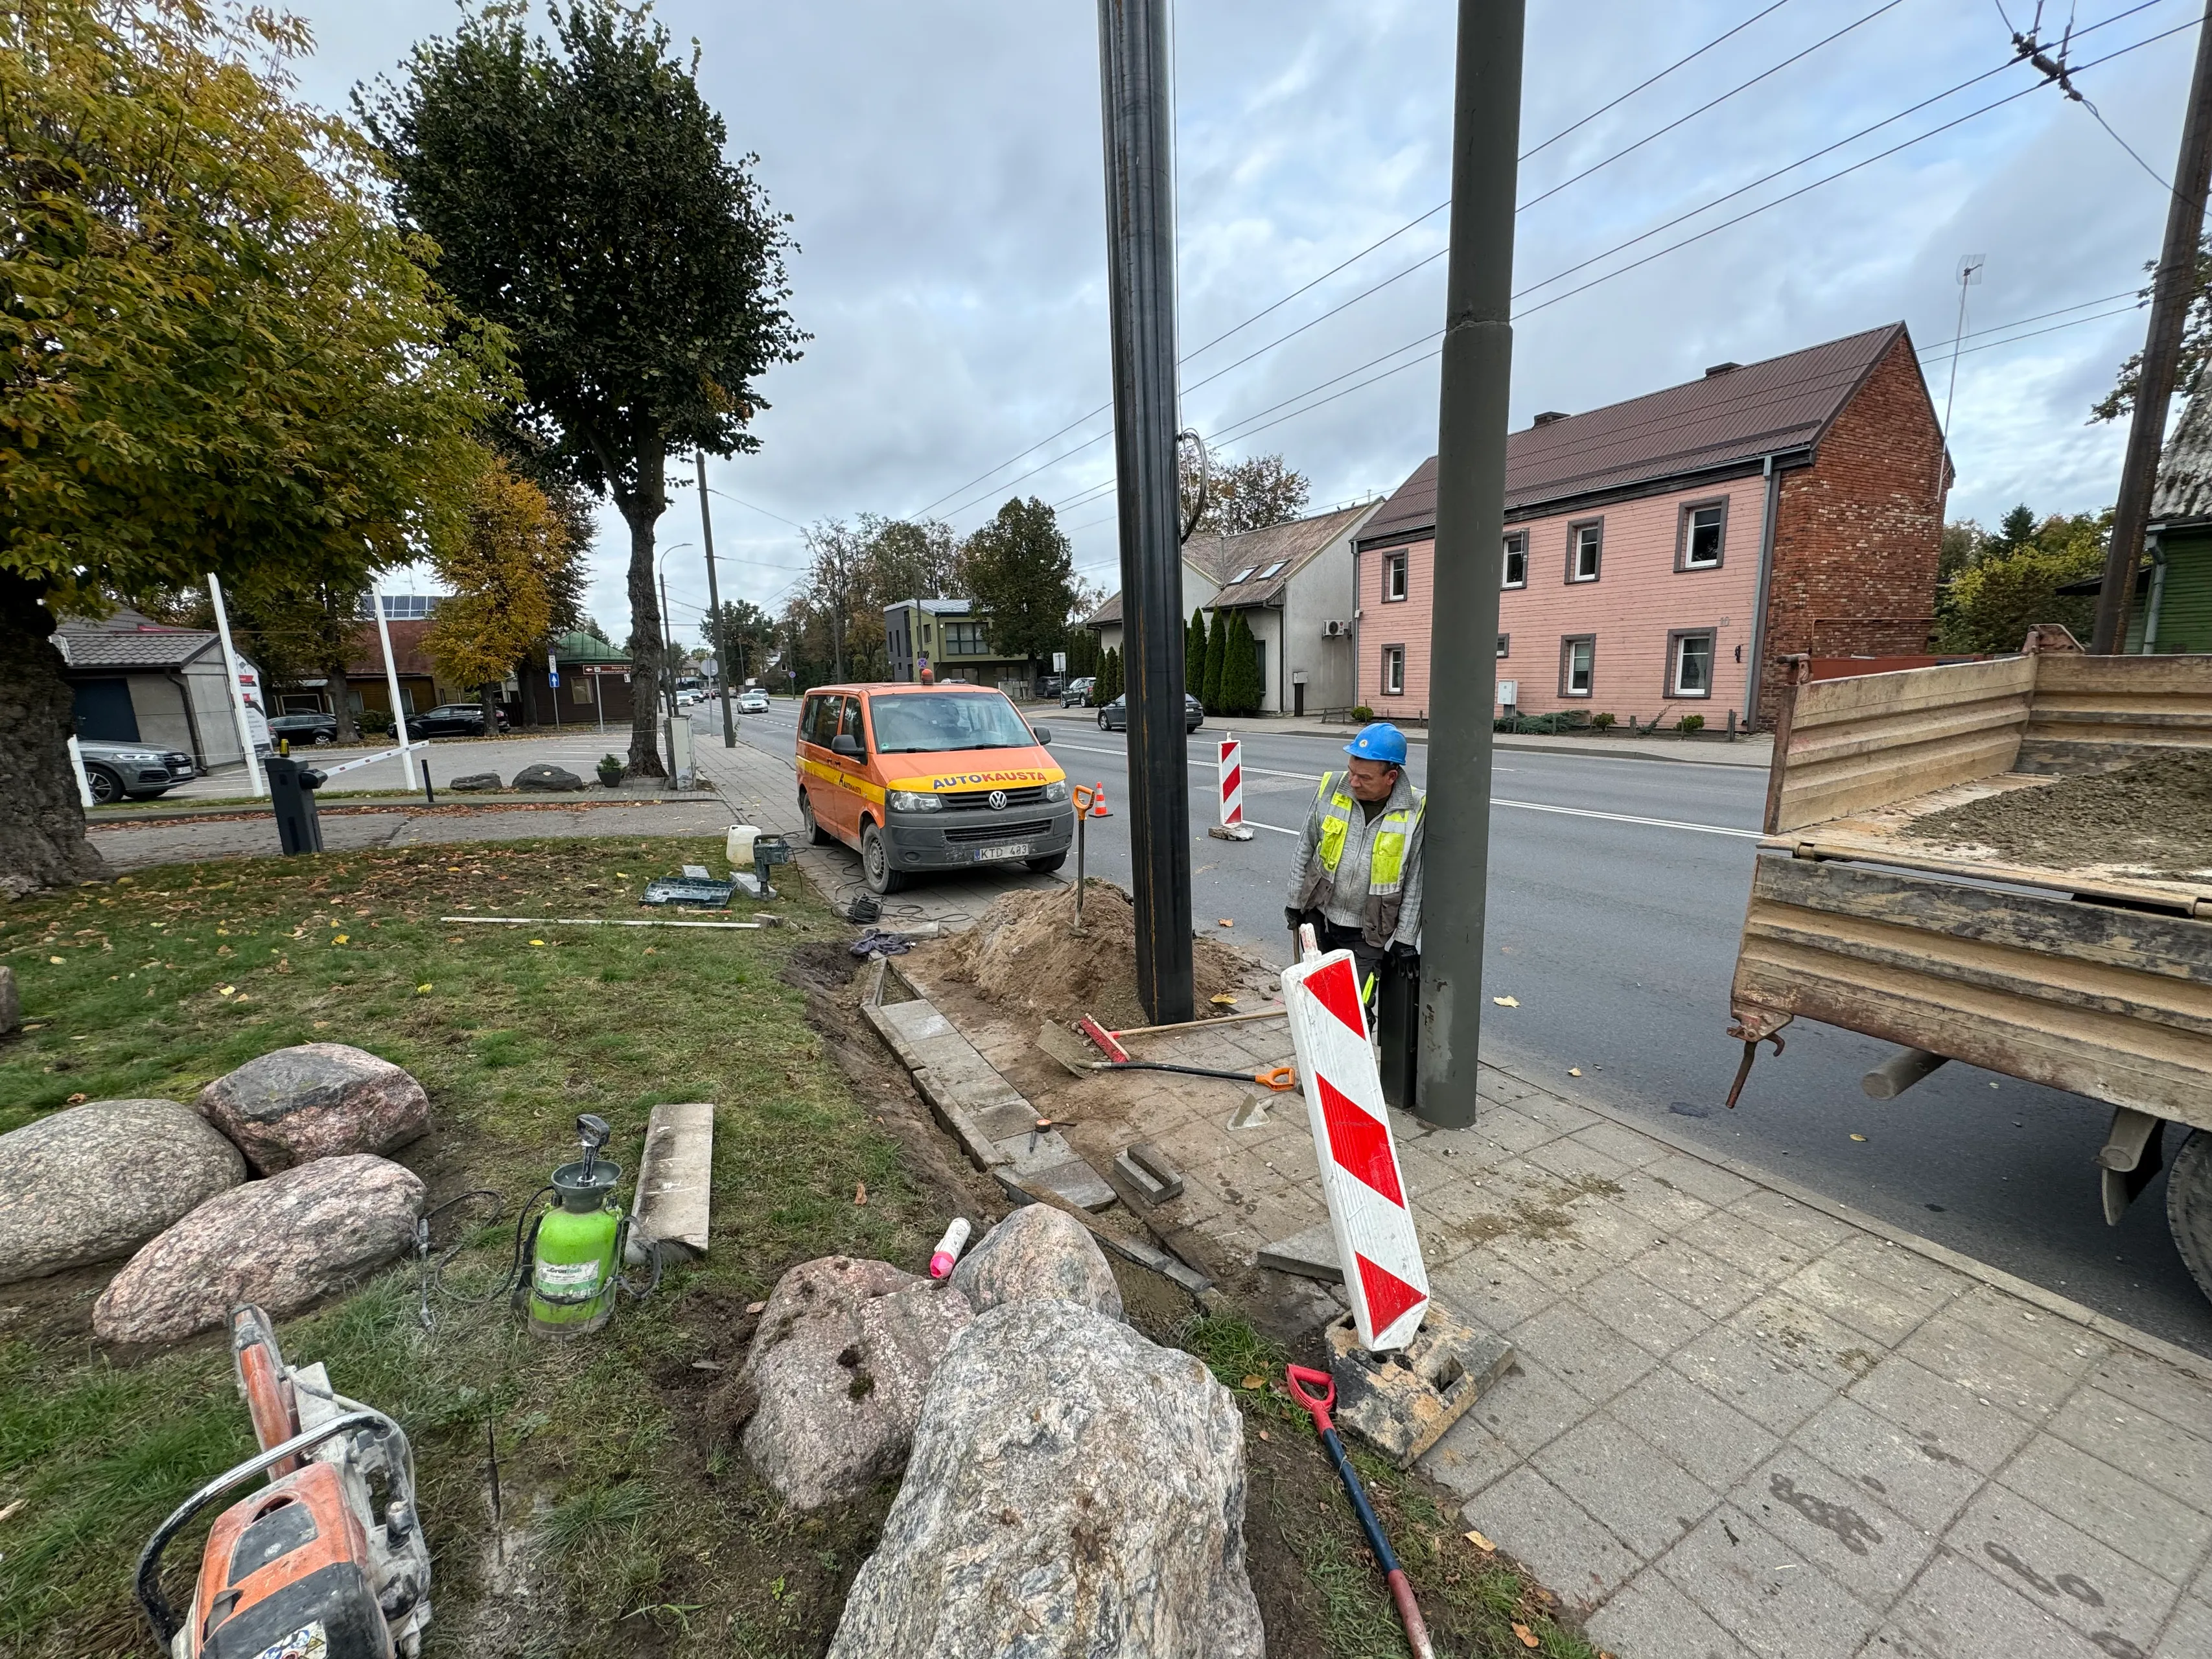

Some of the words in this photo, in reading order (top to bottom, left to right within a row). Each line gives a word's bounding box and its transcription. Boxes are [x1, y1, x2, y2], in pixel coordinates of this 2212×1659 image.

[933, 772, 1047, 790] AUTOKAUSTA
[981, 848, 1003, 859] KTD
[1009, 844, 1027, 855] 483
